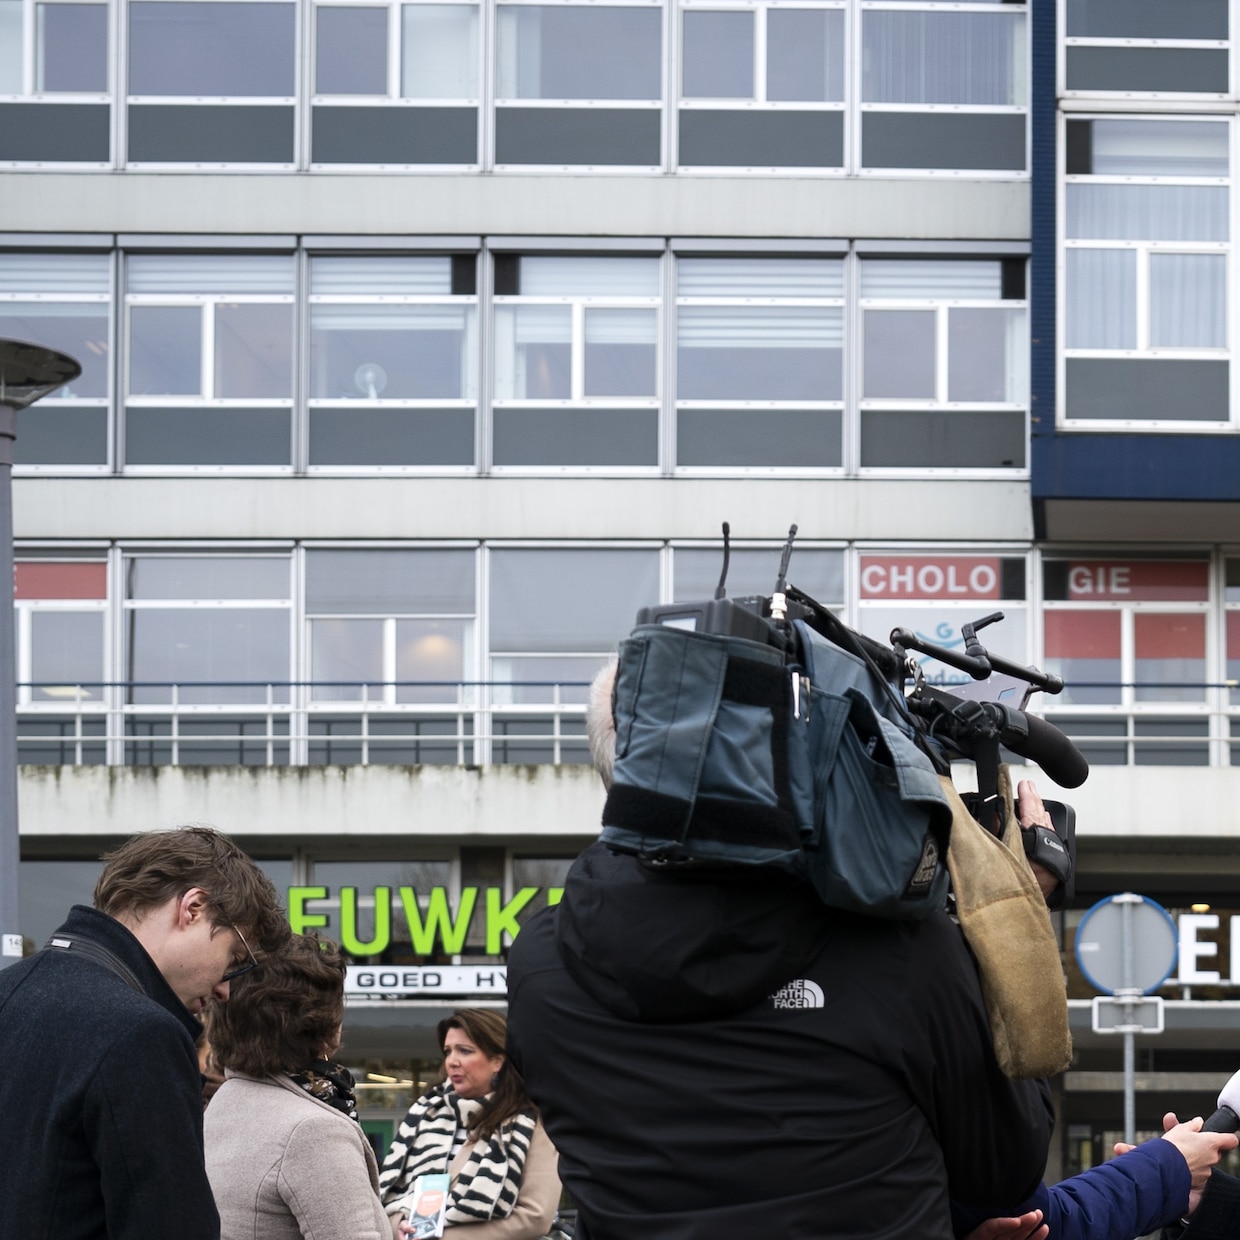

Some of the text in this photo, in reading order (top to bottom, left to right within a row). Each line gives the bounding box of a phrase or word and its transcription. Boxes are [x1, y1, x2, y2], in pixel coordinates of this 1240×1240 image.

[288, 886, 565, 956] EUWK
[356, 972, 442, 987] GOED
[784, 979, 804, 989] HE
[768, 988, 804, 999] ORTH
[774, 998, 804, 1009] FACE
